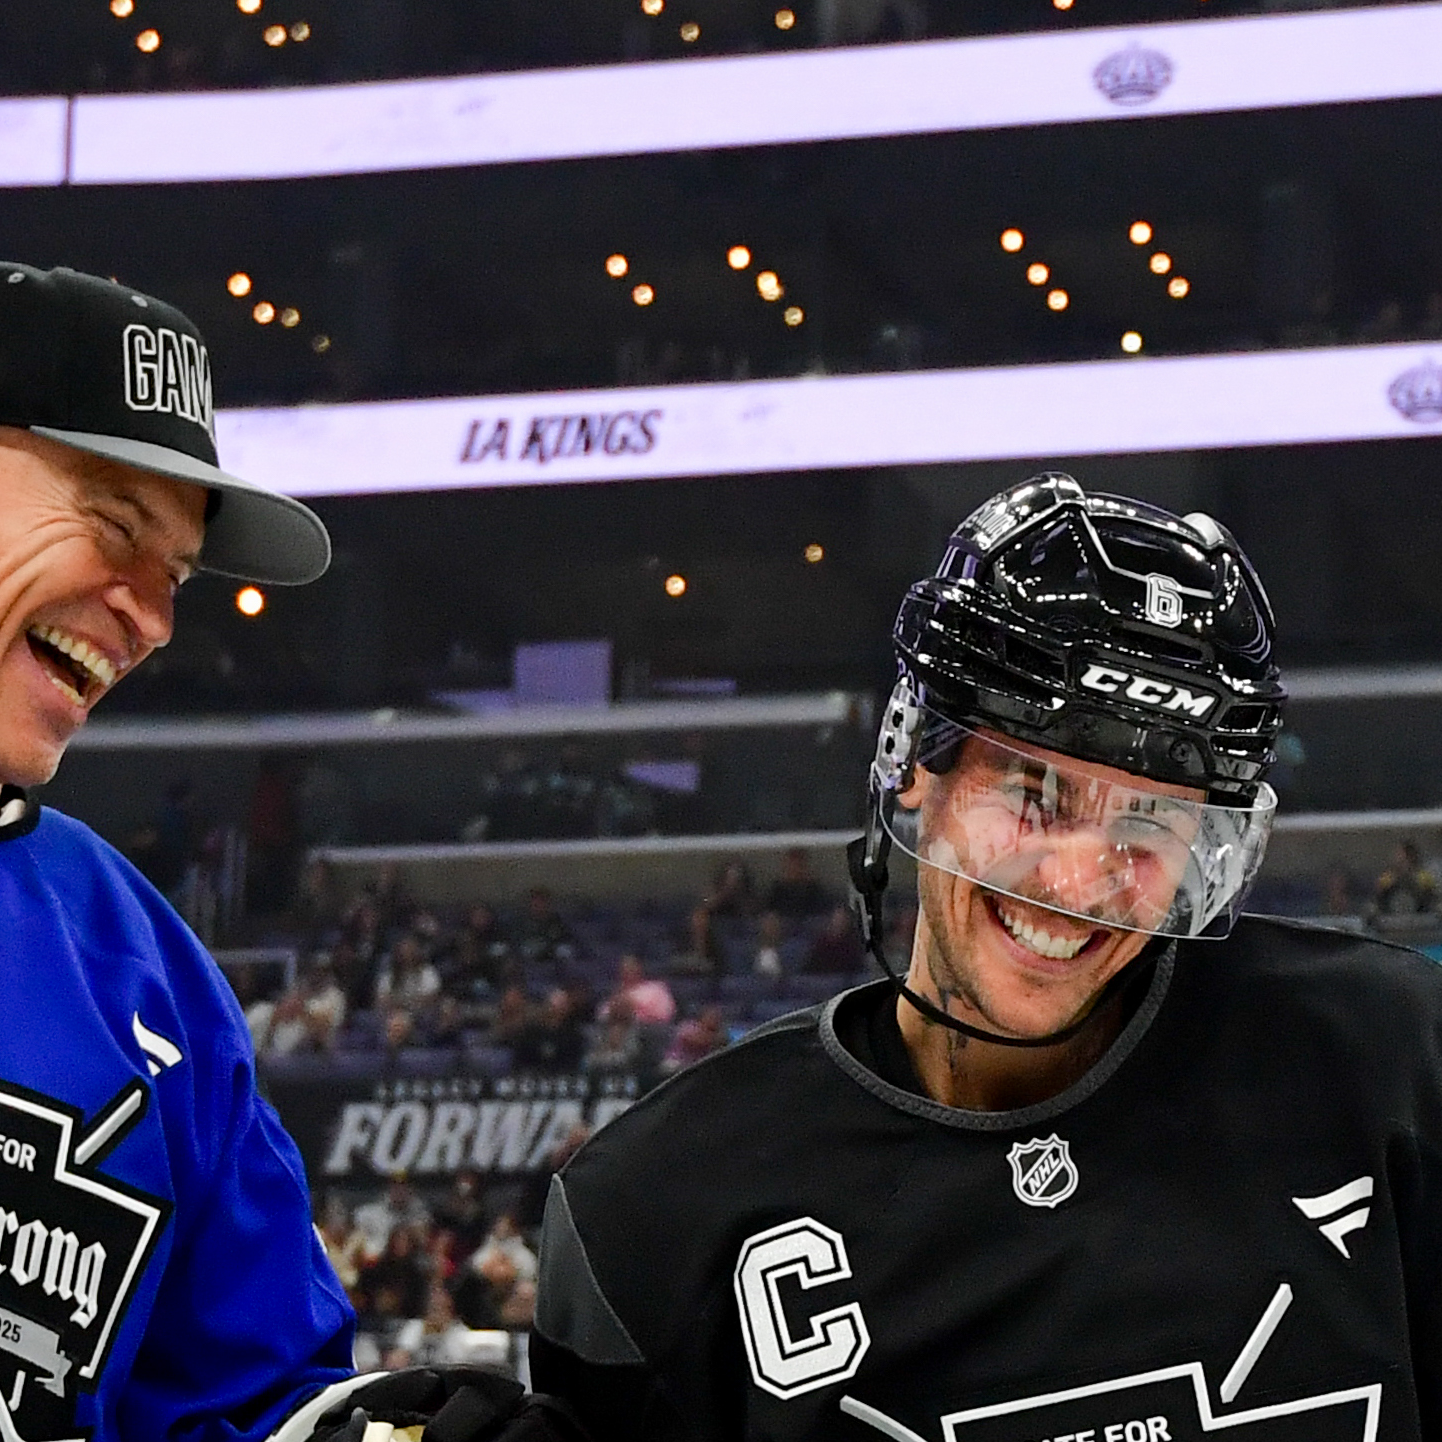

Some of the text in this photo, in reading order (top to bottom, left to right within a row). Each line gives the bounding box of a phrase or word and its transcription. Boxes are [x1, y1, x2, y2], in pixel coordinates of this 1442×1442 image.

[460, 408, 663, 465] LA KINGS
[1145, 571, 1184, 630] 6
[1079, 662, 1217, 717] CCM
[1028, 1152, 1060, 1195] NHL
[734, 1216, 872, 1401] C
